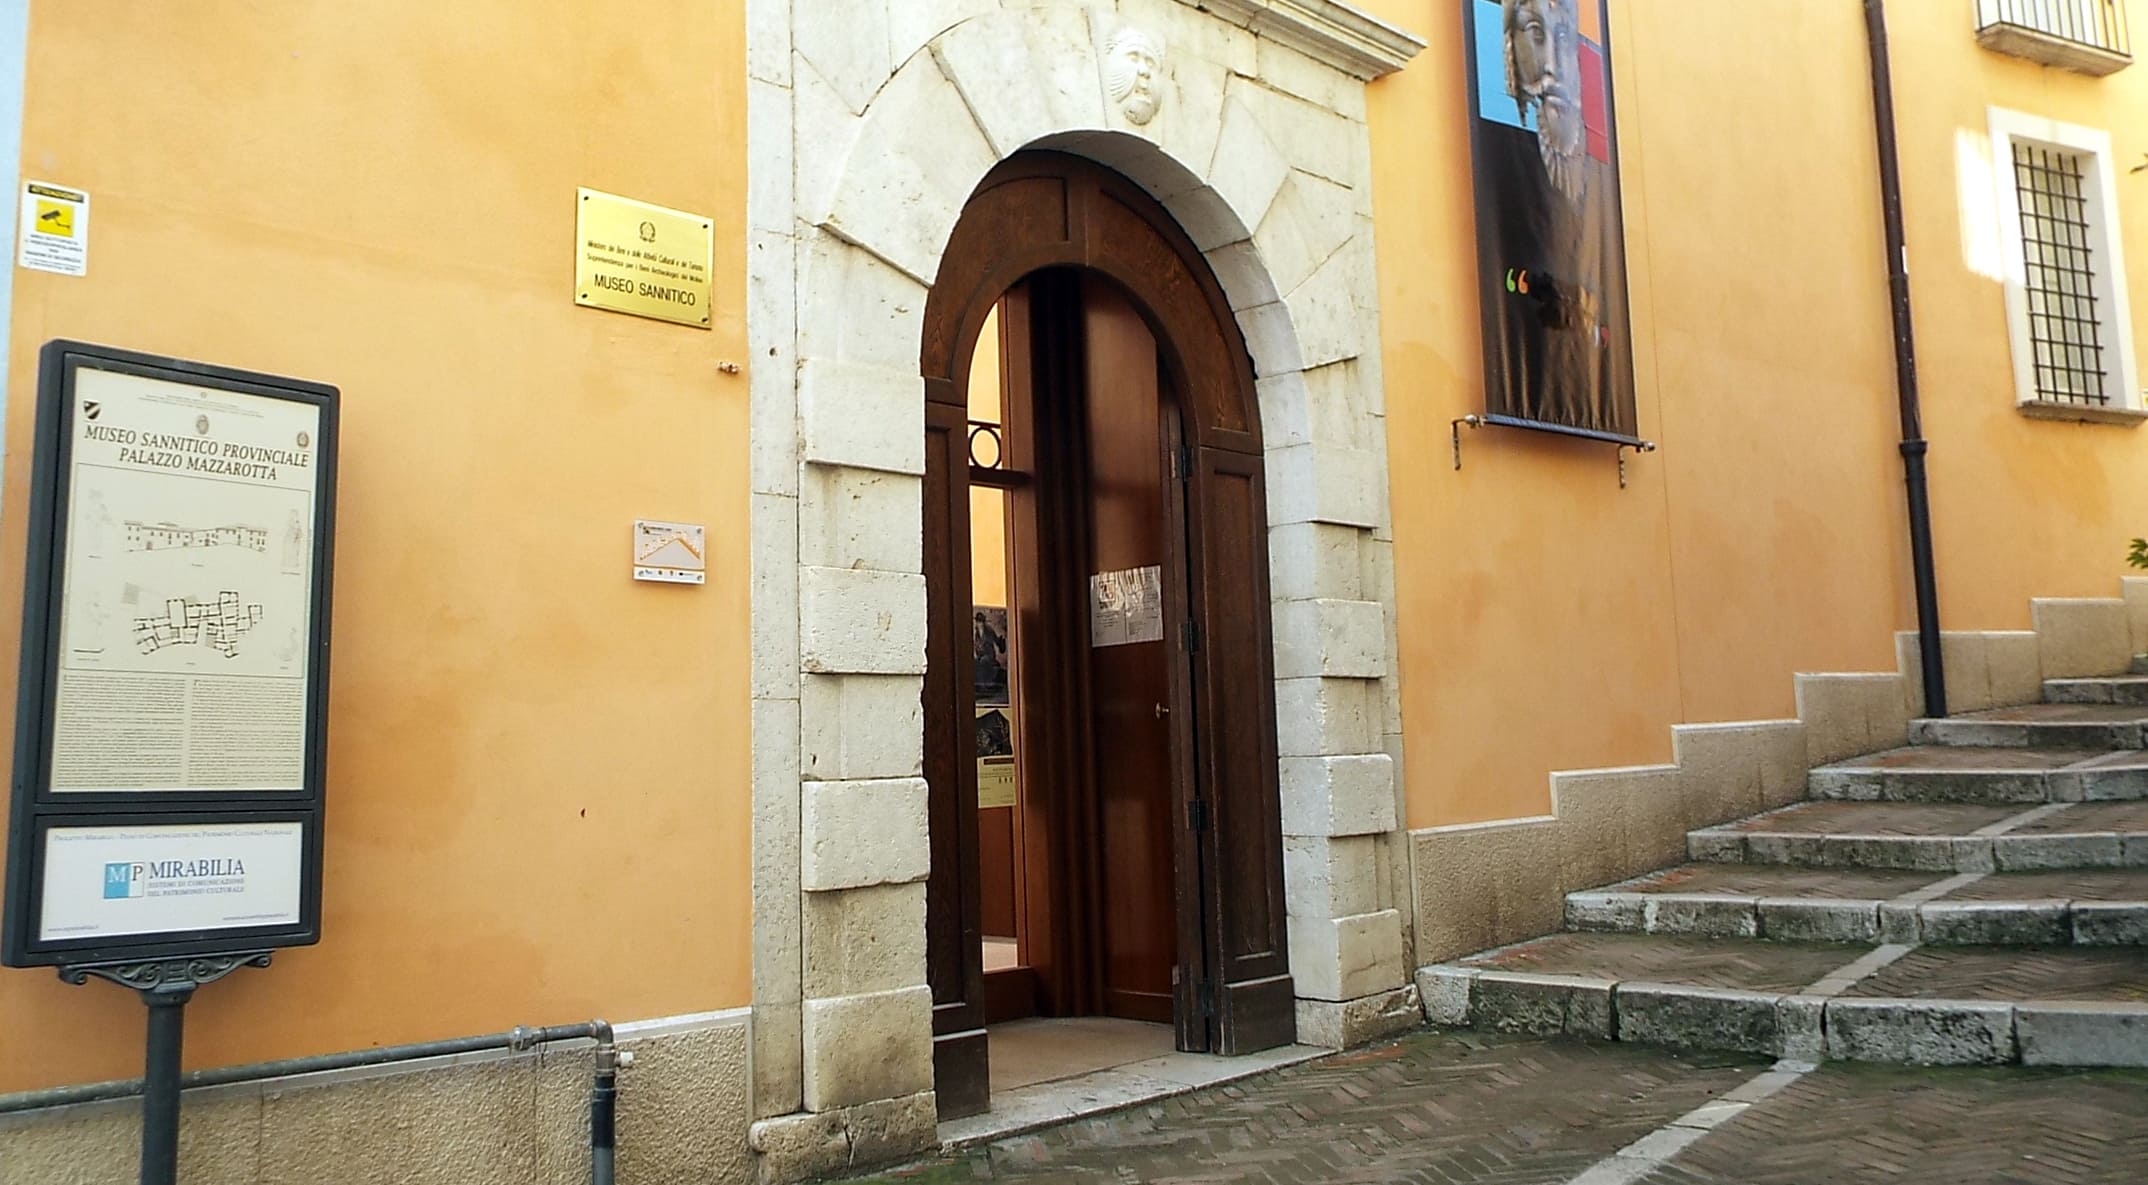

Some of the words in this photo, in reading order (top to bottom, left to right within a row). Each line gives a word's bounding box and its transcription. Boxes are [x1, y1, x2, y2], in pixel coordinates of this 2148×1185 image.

[594, 273, 634, 294] MUSEO
[639, 282, 696, 306] SANNITICO
[84, 424, 136, 445] MUSEO
[141, 432, 218, 456] SANNITICO
[223, 443, 309, 468] PROVINCIALE
[119, 447, 183, 469] PALAZZO
[186, 455, 277, 481] MAZZAROTTA
[149, 858, 245, 879] MIRABILIA
